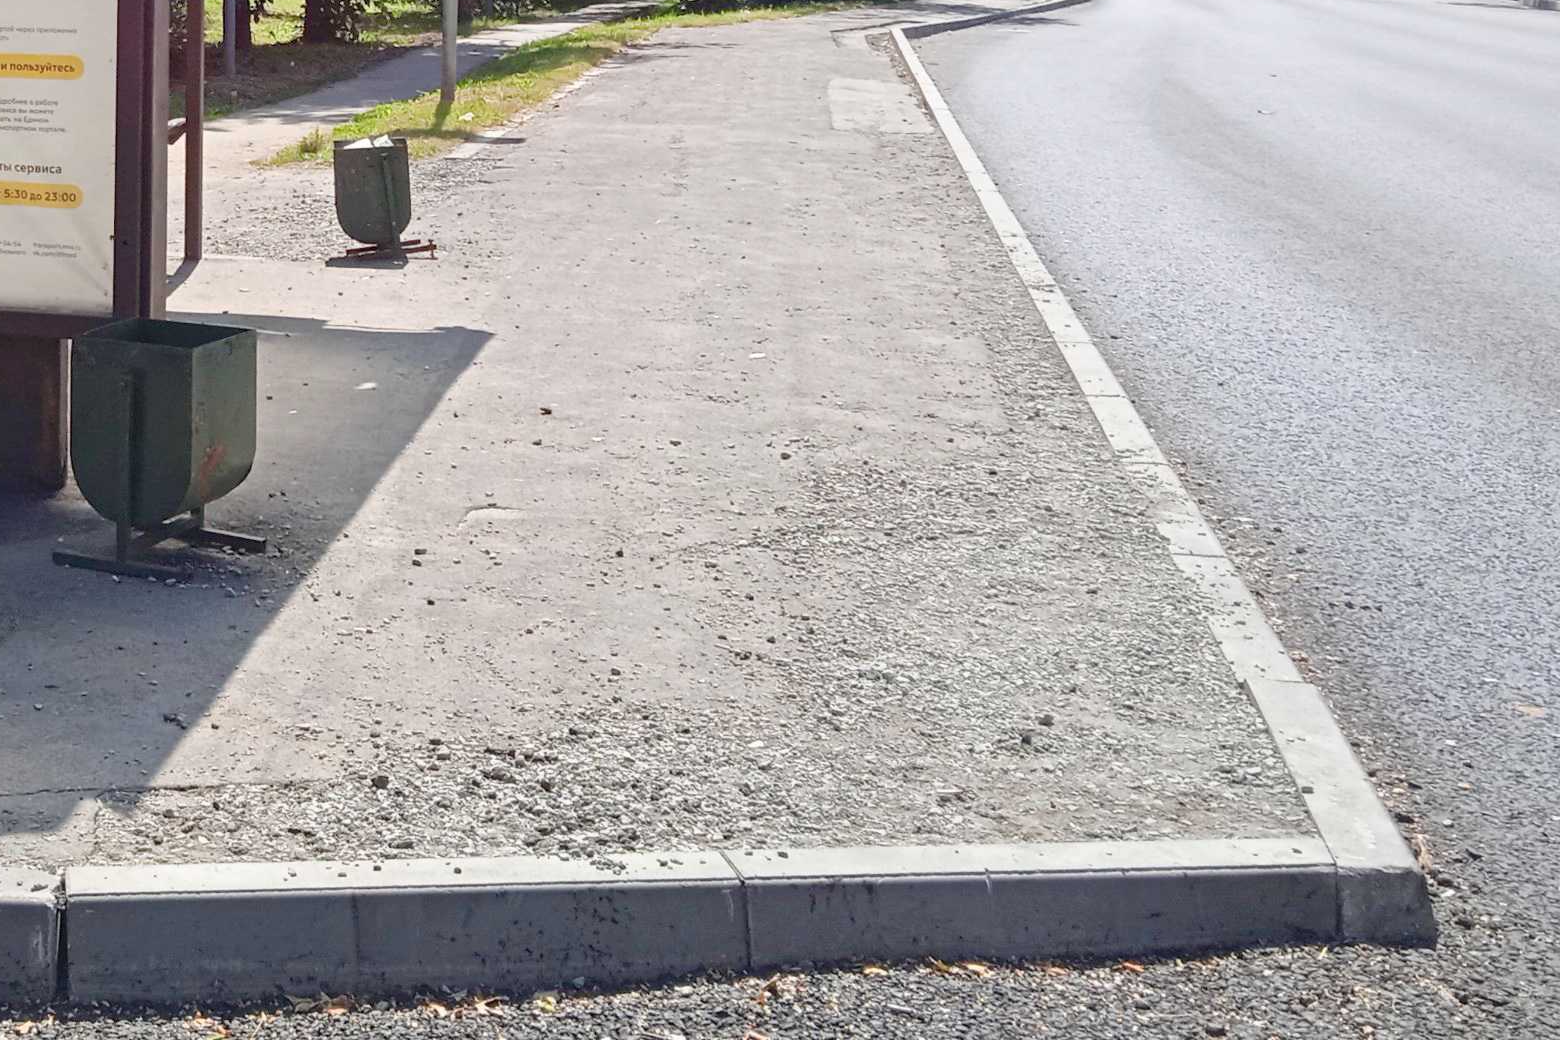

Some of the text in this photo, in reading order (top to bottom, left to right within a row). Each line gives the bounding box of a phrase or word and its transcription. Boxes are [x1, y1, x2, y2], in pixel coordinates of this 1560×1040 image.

[1, 62, 8, 70] и
[10, 60, 75, 74] пользуйтесь
[15, 164, 62, 176] сервиса
[4, 189, 27, 200] 5:30
[29, 193, 42, 201] до
[44, 191, 77, 203] 23:00
